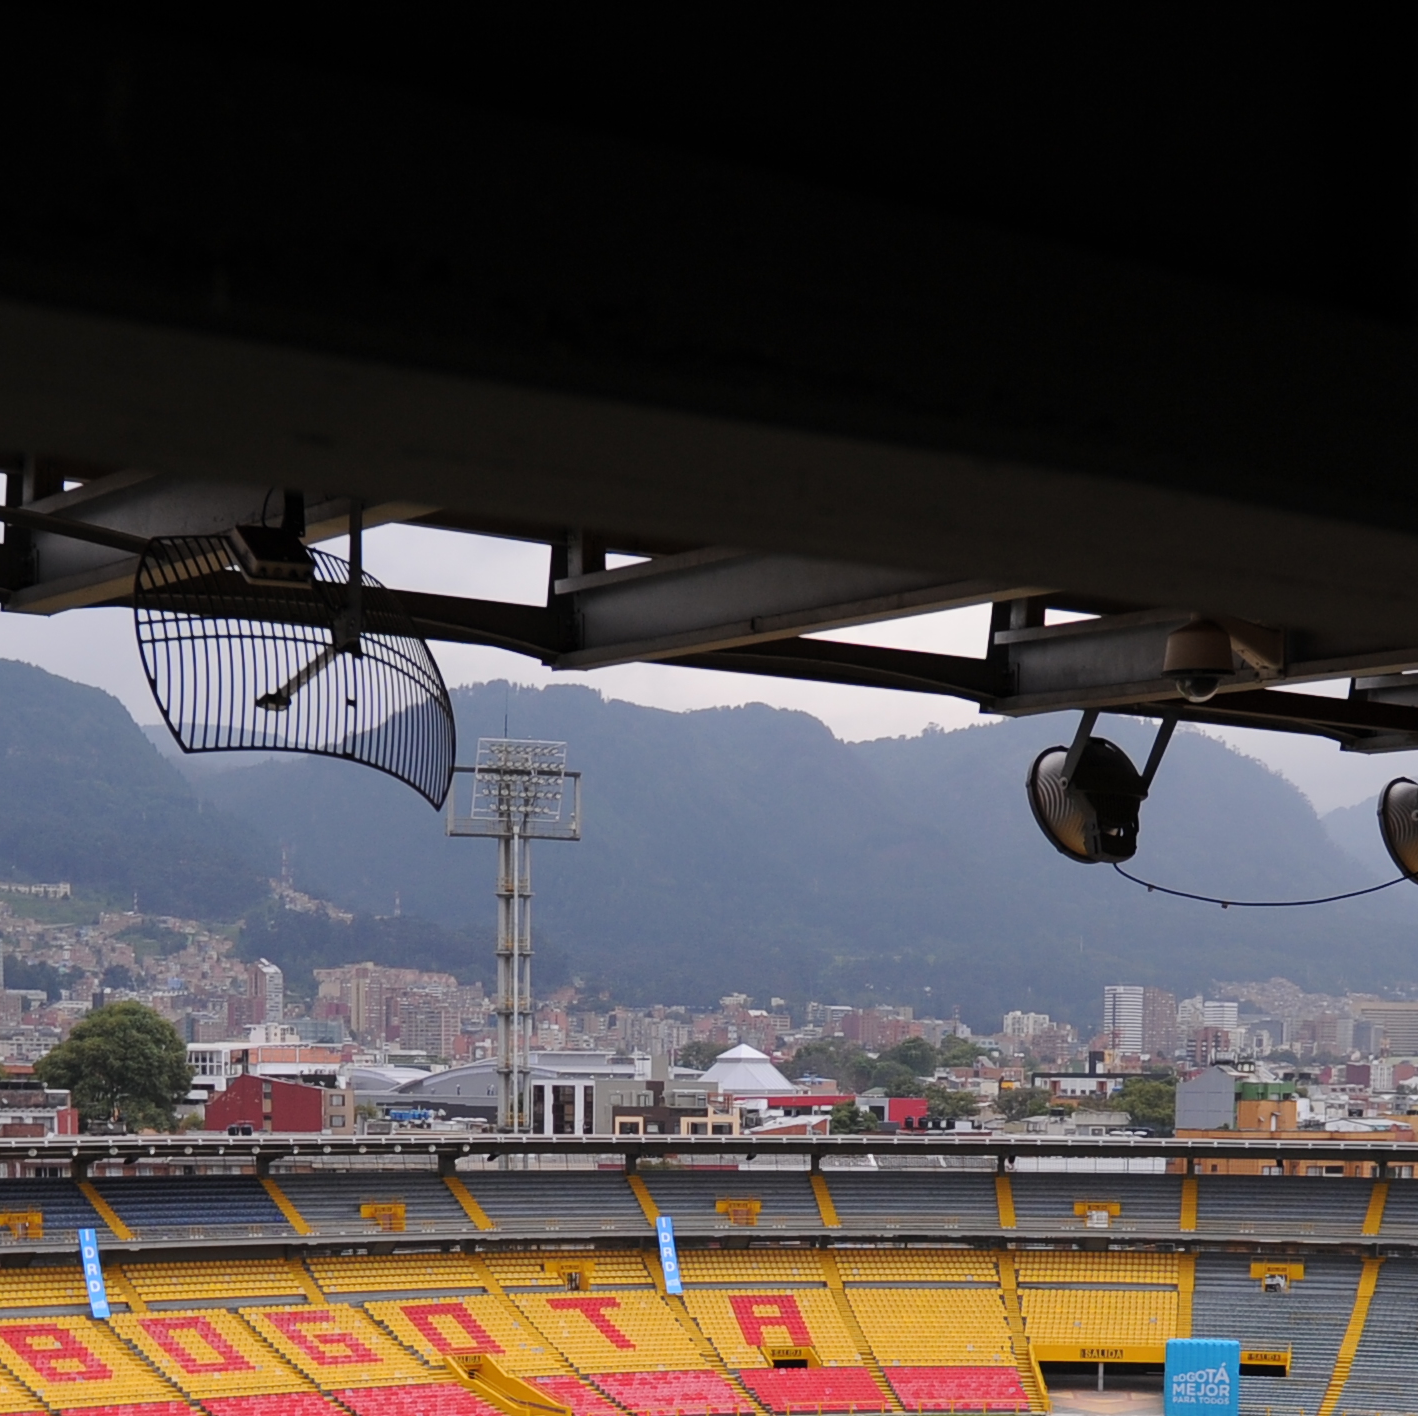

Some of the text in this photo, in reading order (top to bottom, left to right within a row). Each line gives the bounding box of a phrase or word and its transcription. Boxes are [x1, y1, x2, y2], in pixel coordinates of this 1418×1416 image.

[661, 1217, 675, 1272] IDRD
[84, 1228, 100, 1292] IDRD
[1085, 1349, 1123, 1359] SALIDA
[1173, 1362, 1230, 1384] BOGOTÁ
[1173, 1383, 1230, 1397] MEJOR
[1173, 1396, 1230, 1405] PARA TODOS
